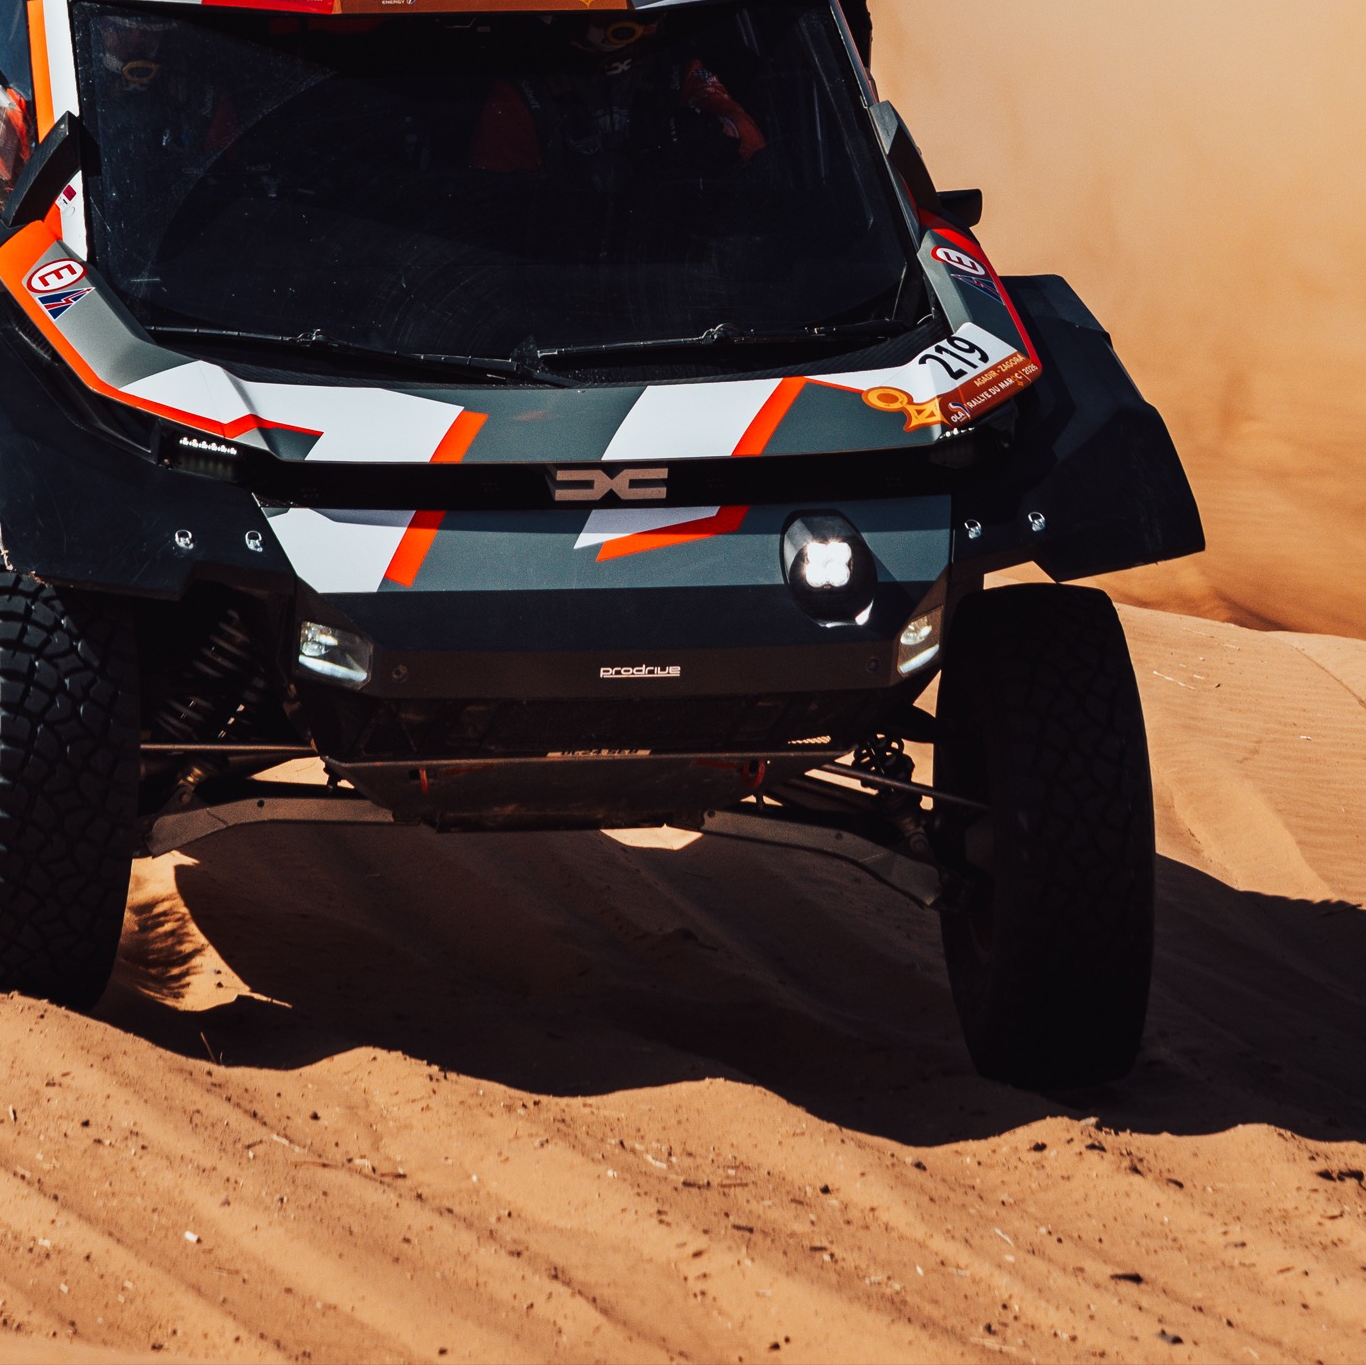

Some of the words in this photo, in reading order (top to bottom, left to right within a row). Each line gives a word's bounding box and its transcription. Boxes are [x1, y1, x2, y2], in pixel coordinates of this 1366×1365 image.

[918, 335, 989, 381] 219
[973, 370, 999, 387] AGADIR
[997, 353, 1026, 372] ZAGORA
[950, 411, 965, 422] OLA
[966, 391, 992, 408] RALLYE
[988, 385, 1001, 395] DU
[600, 664, 681, 678] prodrive
